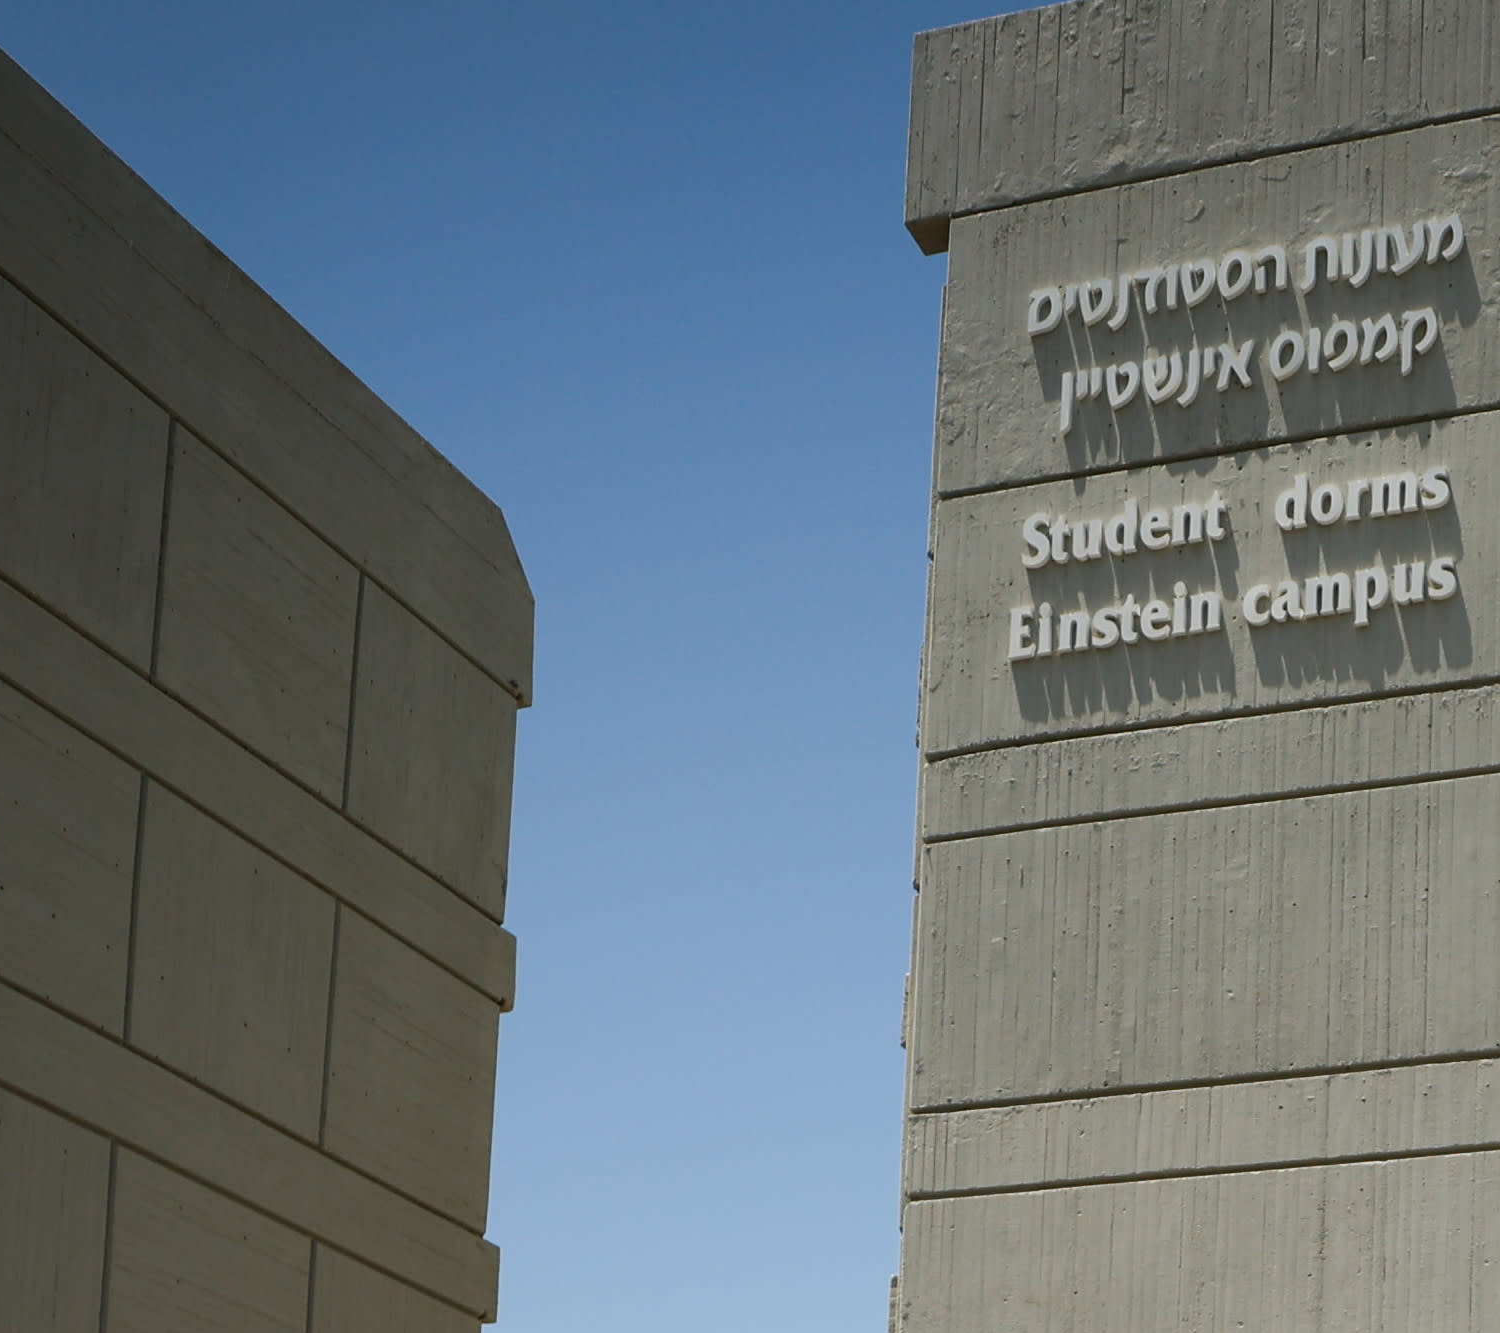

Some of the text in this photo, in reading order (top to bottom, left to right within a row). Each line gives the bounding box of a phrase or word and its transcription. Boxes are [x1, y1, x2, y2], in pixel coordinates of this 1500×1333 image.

[1027, 213, 1464, 337] מעונות הסטודנטים
[1059, 307, 1440, 438] קמפוס אינשטיין
[1023, 466, 1452, 569] Student dorms
[1008, 557, 1458, 662] Einstein campus
